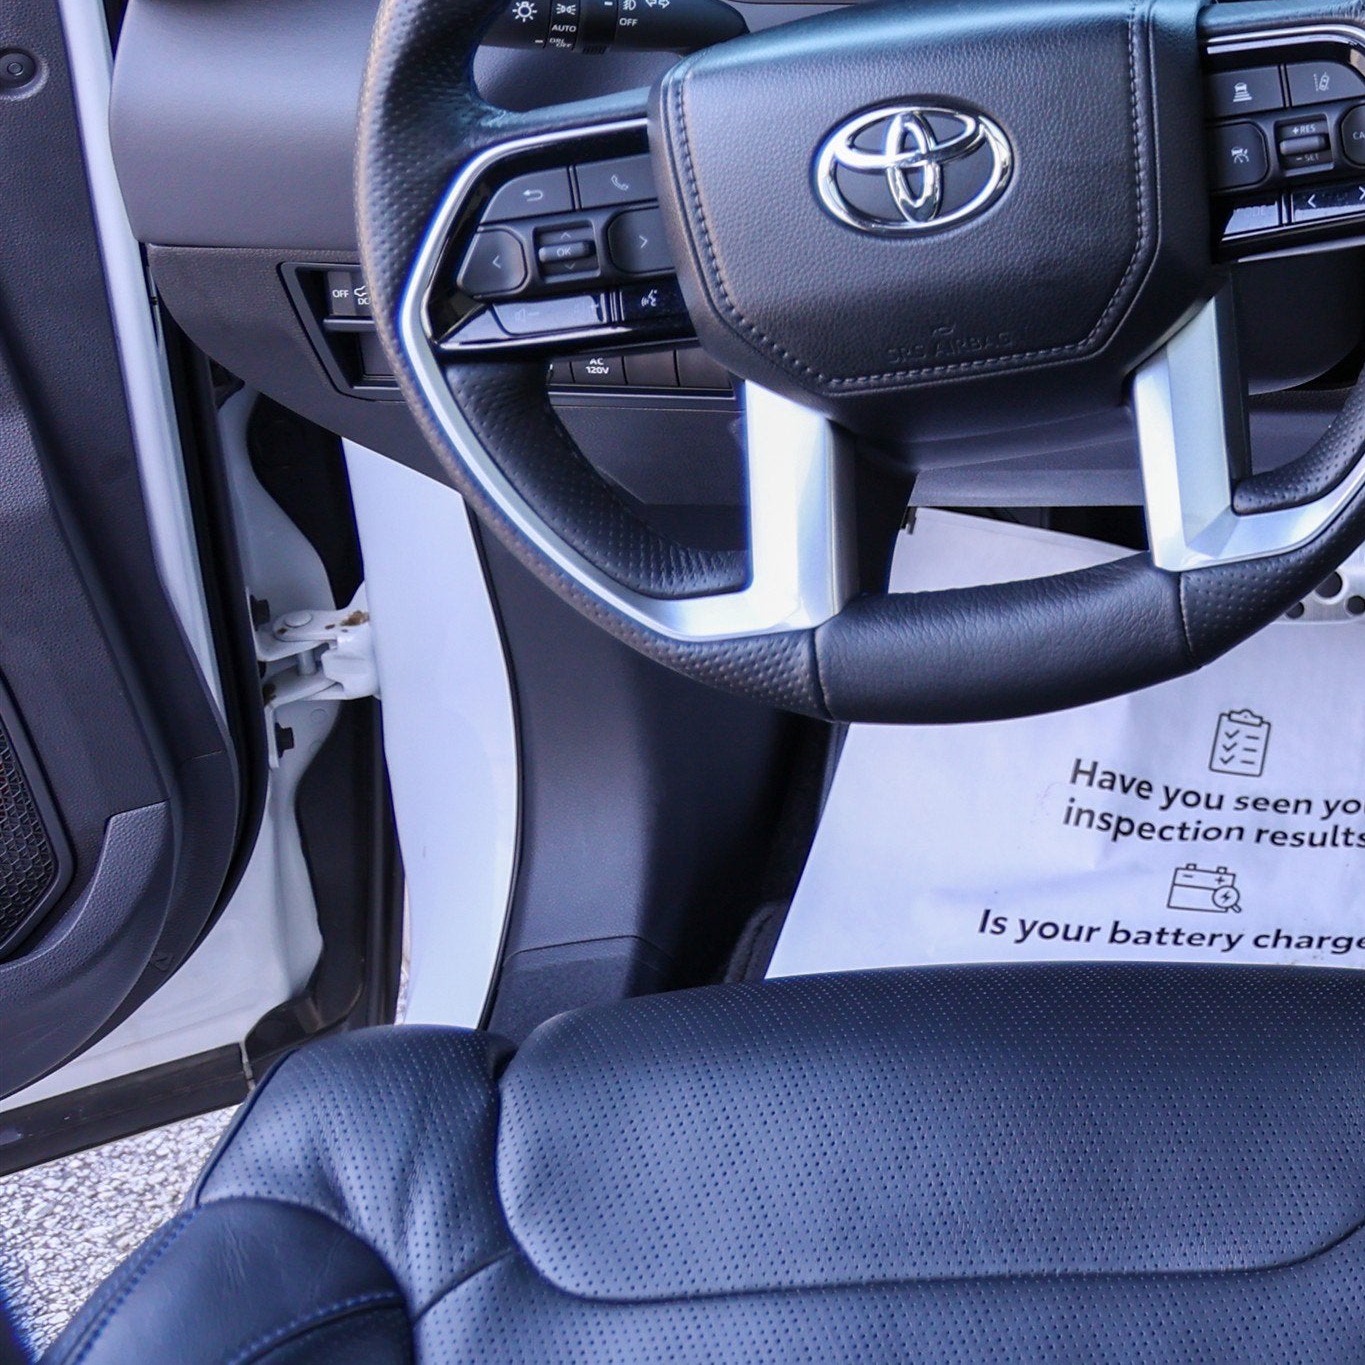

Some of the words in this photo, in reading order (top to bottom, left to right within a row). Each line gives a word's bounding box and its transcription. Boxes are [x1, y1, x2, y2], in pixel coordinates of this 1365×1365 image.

[619, 18, 638, 26] OFF
[552, 25, 576, 33] AUTO
[556, 246, 571, 257] OK
[332, 289, 349, 298] OFF
[586, 366, 609, 375] 120V
[1068, 756, 1154, 801] Have
[1159, 776, 1223, 812] you
[1233, 791, 1312, 817] seen
[1062, 796, 1245, 844] inspection
[977, 908, 1007, 936] Is
[1017, 916, 1101, 945] your
[1108, 920, 1244, 953] battery
